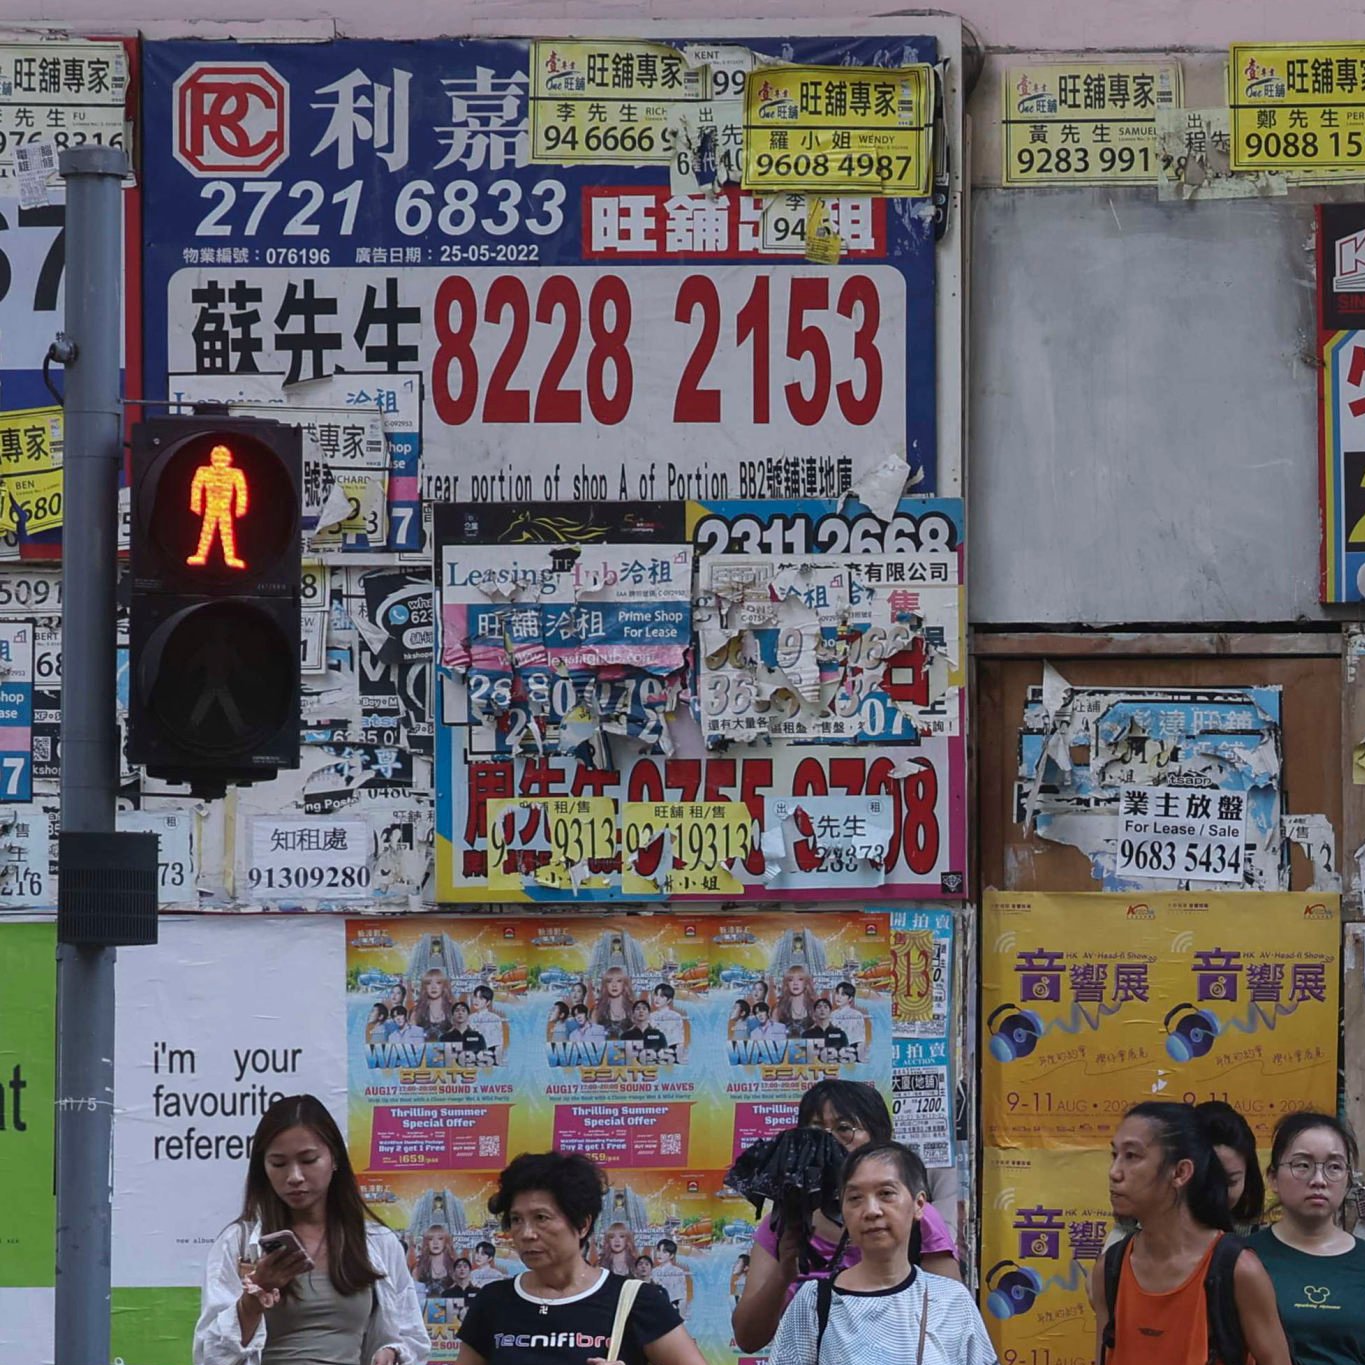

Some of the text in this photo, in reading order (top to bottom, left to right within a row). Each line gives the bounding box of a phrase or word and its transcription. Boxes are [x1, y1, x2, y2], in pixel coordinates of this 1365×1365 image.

[13, 57, 110, 94] 旺舖專家
[587, 54, 683, 89] 旺舖專家
[801, 81, 896, 117] 旺舖專家
[1059, 74, 1155, 110] 旺舖專家
[557, 102, 638, 122] 李先生
[1257, 110, 1339, 128] 鄭先生
[584, 124, 654, 151] 6666
[769, 131, 896, 150] 羅小姐 WENDY
[1028, 125, 1112, 144] 黃先生
[1246, 132, 1319, 158] 9088
[756, 153, 912, 181] 9608 4987
[1018, 148, 1090, 173] 9283
[196, 179, 566, 237] 2721 6833
[266, 244, 539, 264] 076196 25-05-2022
[432, 274, 633, 426] 8228
[673, 274, 883, 426] 2153
[618, 611, 683, 625] Prime Shop
[623, 627, 678, 638] For Lease
[1124, 790, 1243, 821] 業主放盤
[270, 828, 348, 852] 知租處
[1125, 820, 1240, 838] For Lease Sale
[1120, 839, 1241, 875] 9683 5434
[248, 865, 370, 889] 91309280
[1014, 947, 1150, 1003] 音響展
[1191, 947, 1328, 1003] 音響展
[153, 1041, 303, 1082] i'm your
[438, 1085, 470, 1095] SOUND
[390, 1107, 488, 1118] Thrilling Summer
[1006, 1093, 1089, 1113] 9-11 AUG
[402, 1119, 477, 1129] Special Offer
